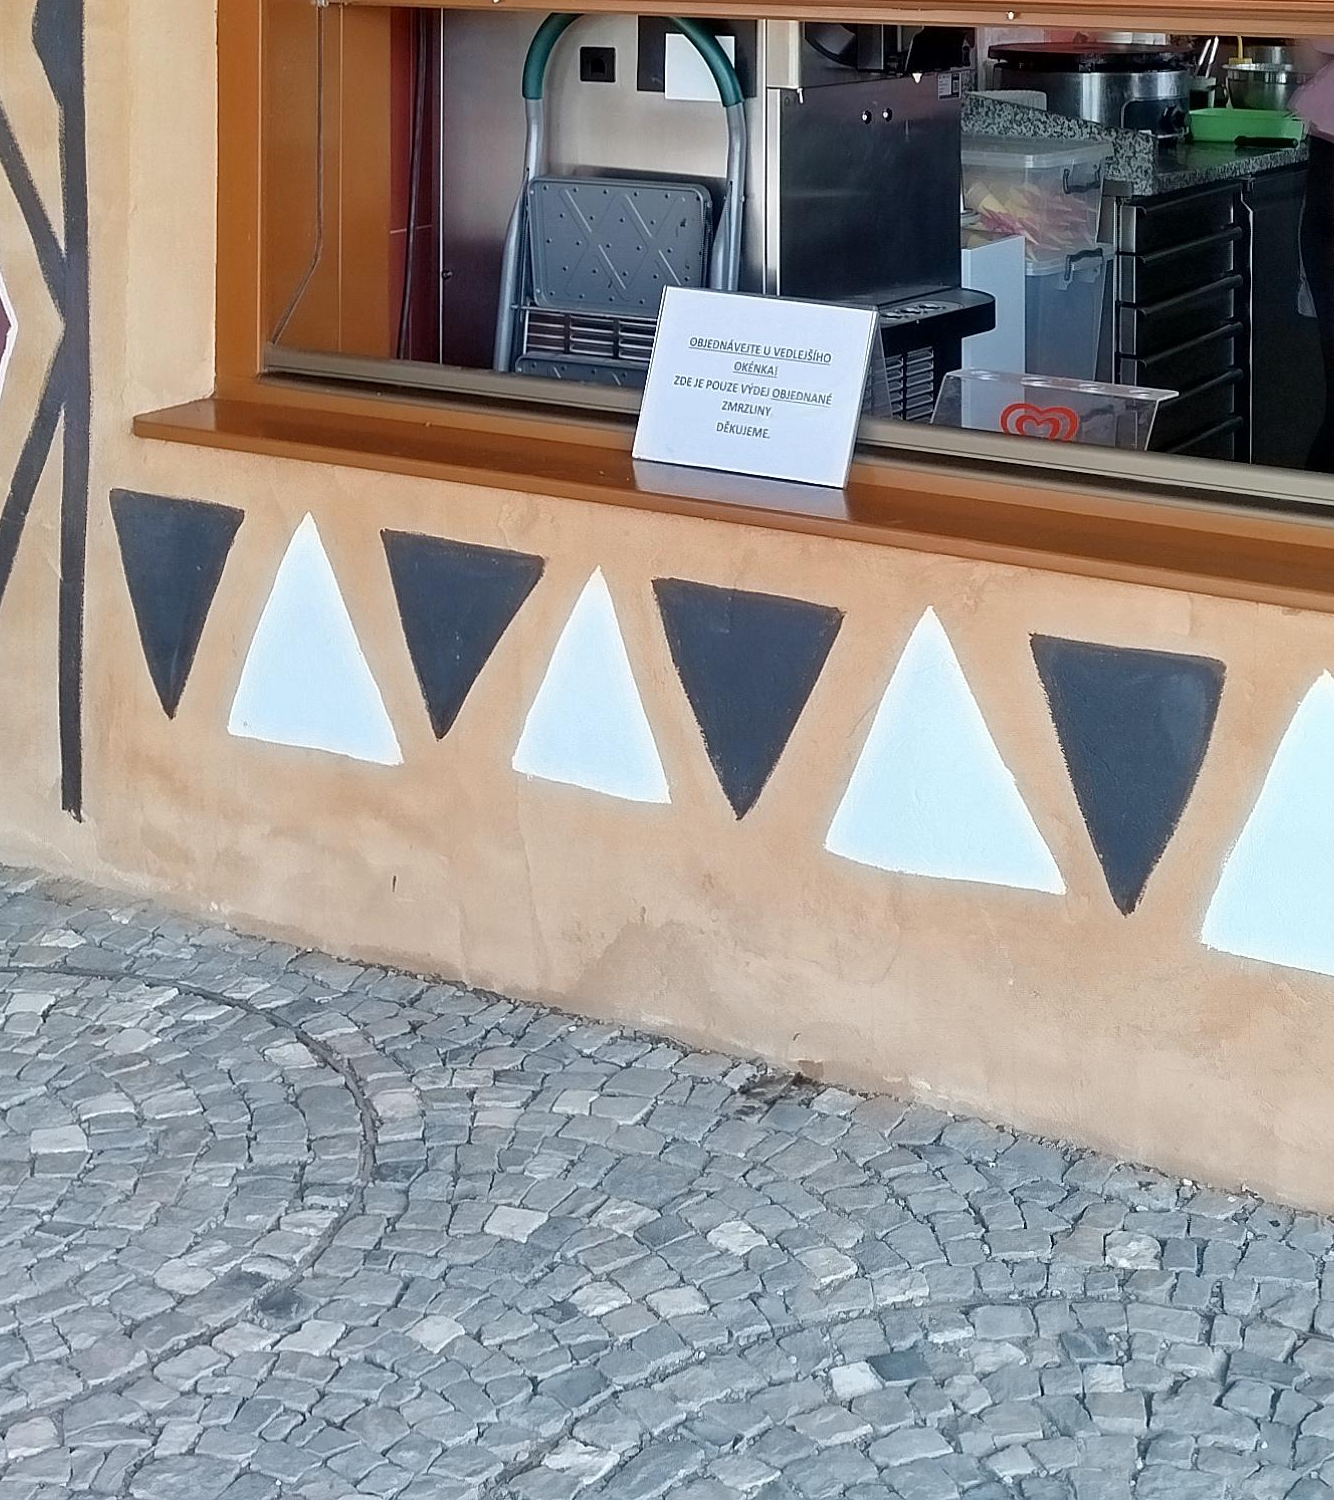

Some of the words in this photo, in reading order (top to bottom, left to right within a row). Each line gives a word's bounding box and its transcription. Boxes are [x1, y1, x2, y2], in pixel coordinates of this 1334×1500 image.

[689, 336, 761, 356] OBJEDNÁVEJTE
[763, 345, 771, 357] U
[774, 347, 832, 364] VEDLEJŠÍHO
[733, 361, 778, 376] OKÉNKA!
[673, 375, 692, 387] ZDE
[693, 378, 705, 389] JE
[705, 379, 738, 393] POUZE
[741, 383, 770, 397] VÝDEJ
[772, 388, 833, 406] OBJEDNANÉ
[722, 401, 772, 417] ZMRZLINY
[716, 421, 770, 439] DĚKUJEME.
